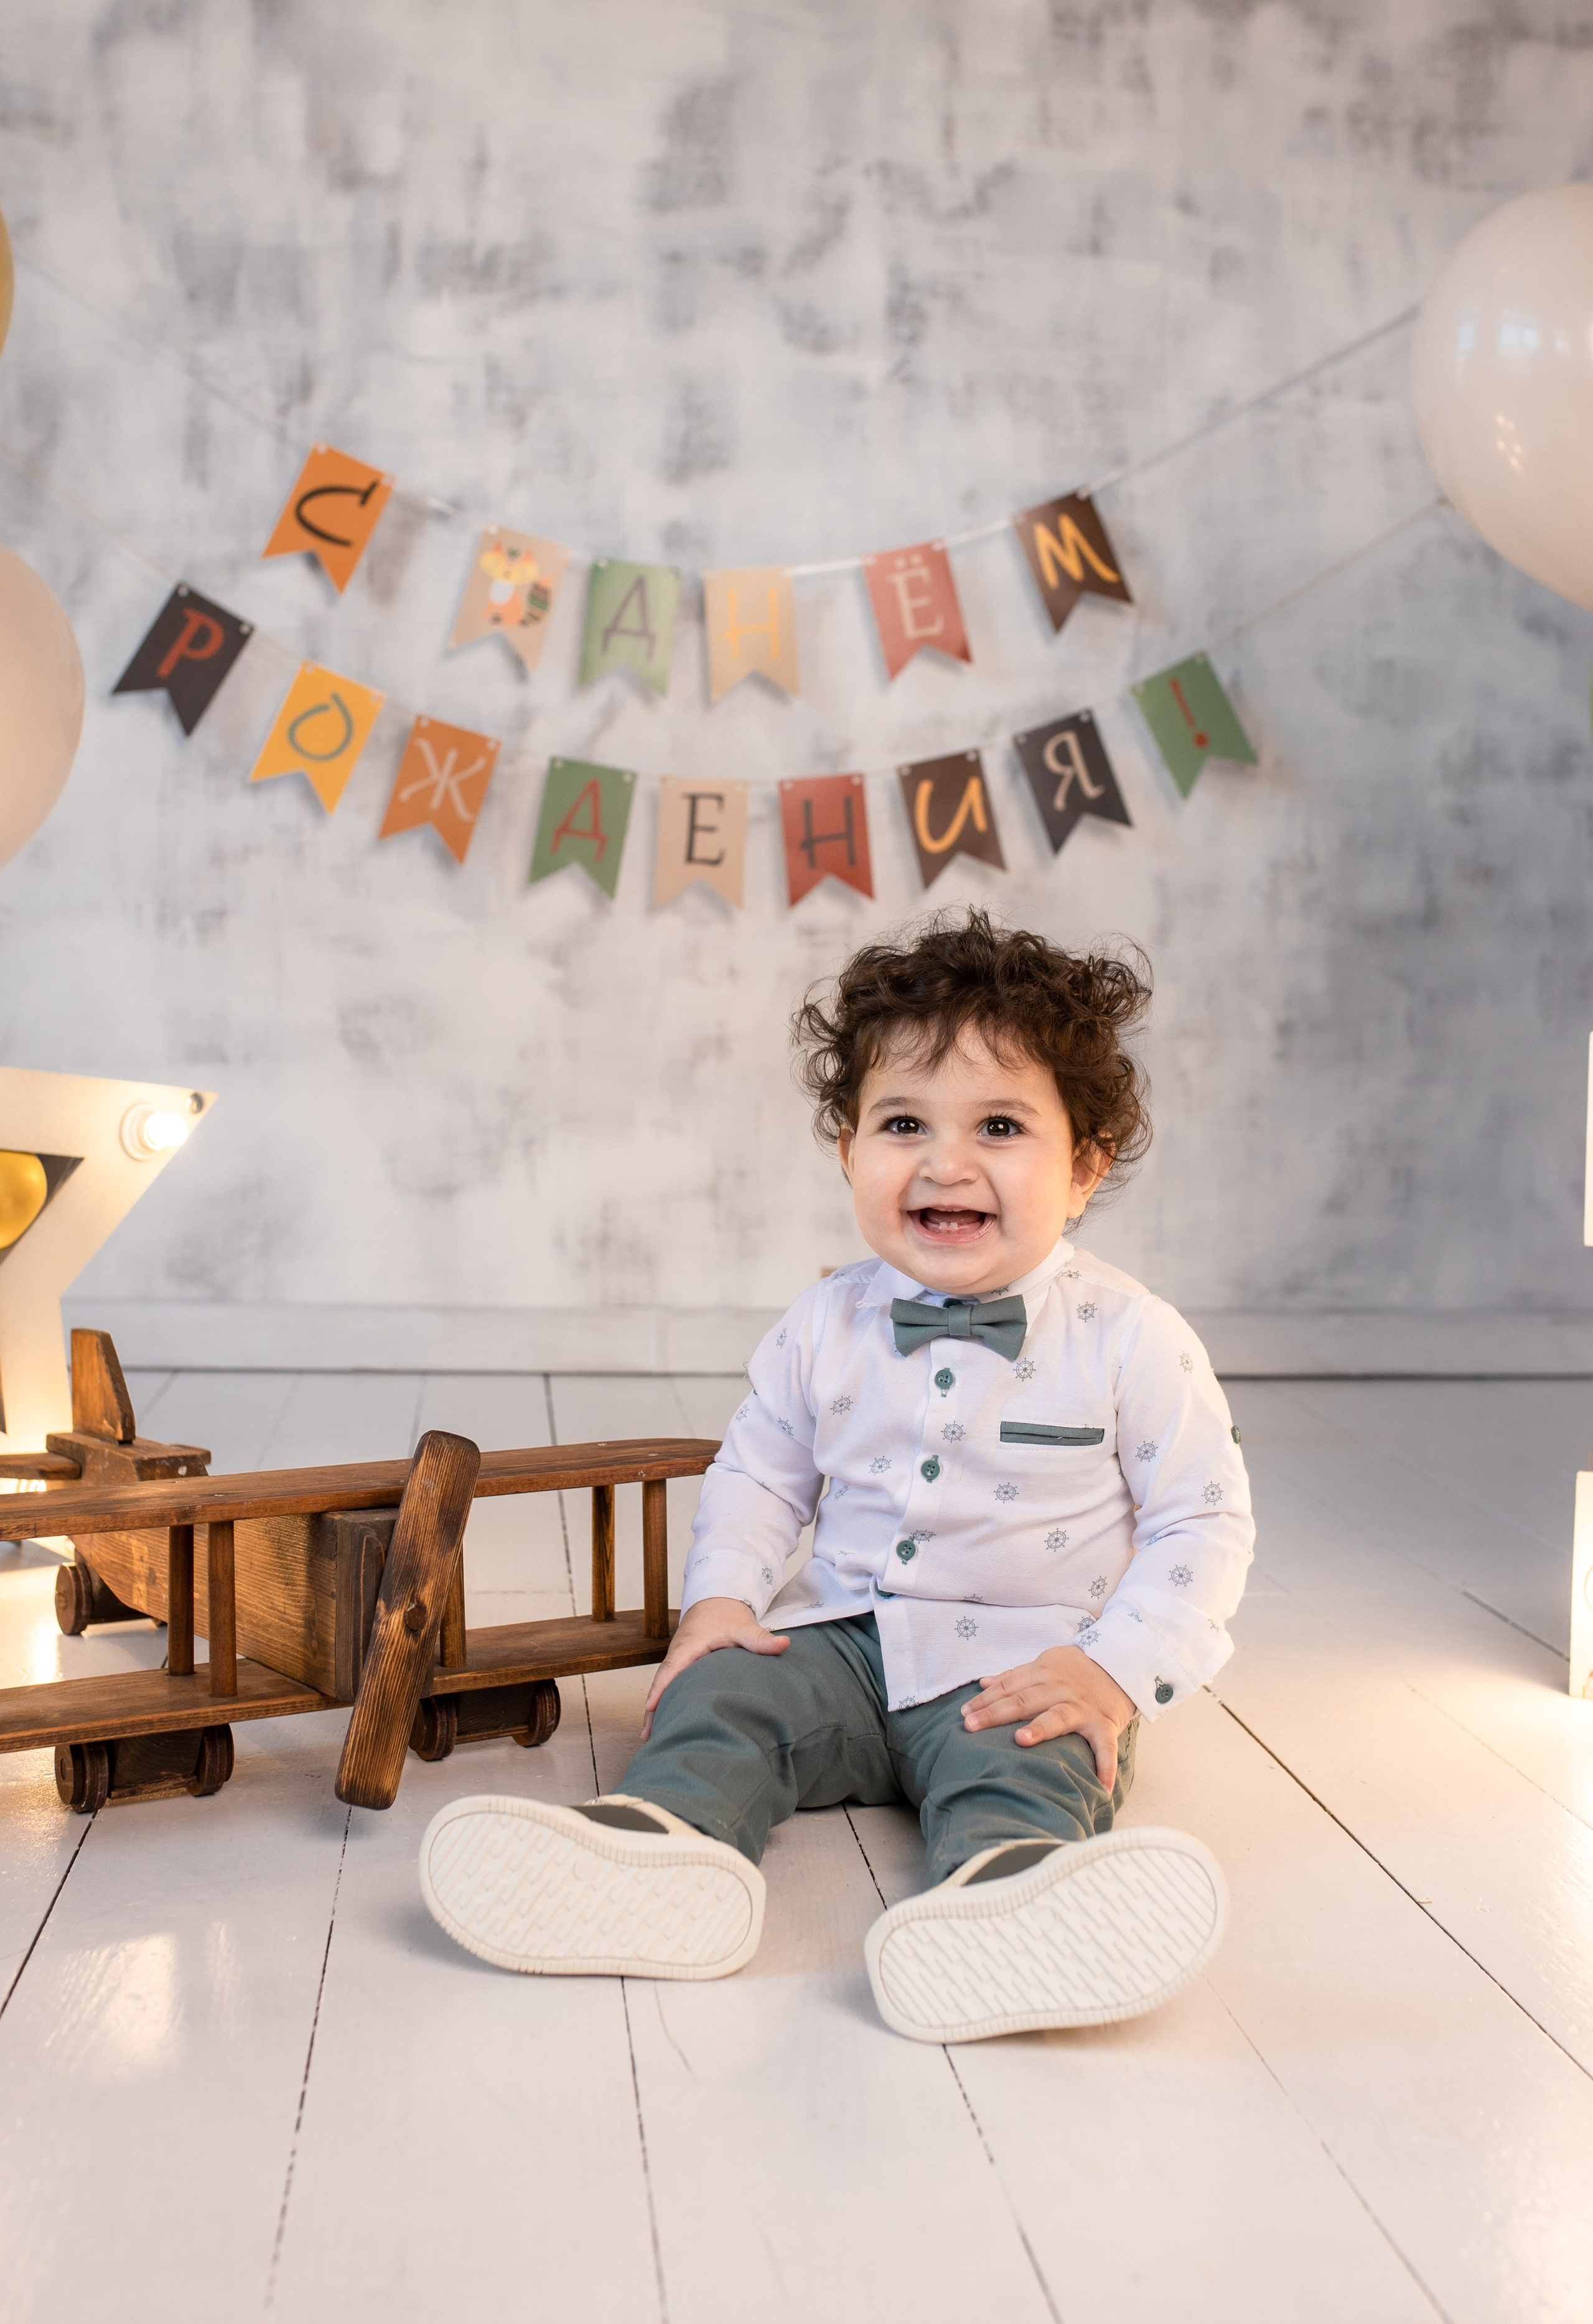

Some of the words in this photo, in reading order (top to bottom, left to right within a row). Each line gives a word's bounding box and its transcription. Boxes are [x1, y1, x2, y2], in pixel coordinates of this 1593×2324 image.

[295, 478, 379, 549] С
[599, 512, 1120, 662] ДНЁМ
[155, 607, 1210, 870] РОЖДЕНИЯ!
